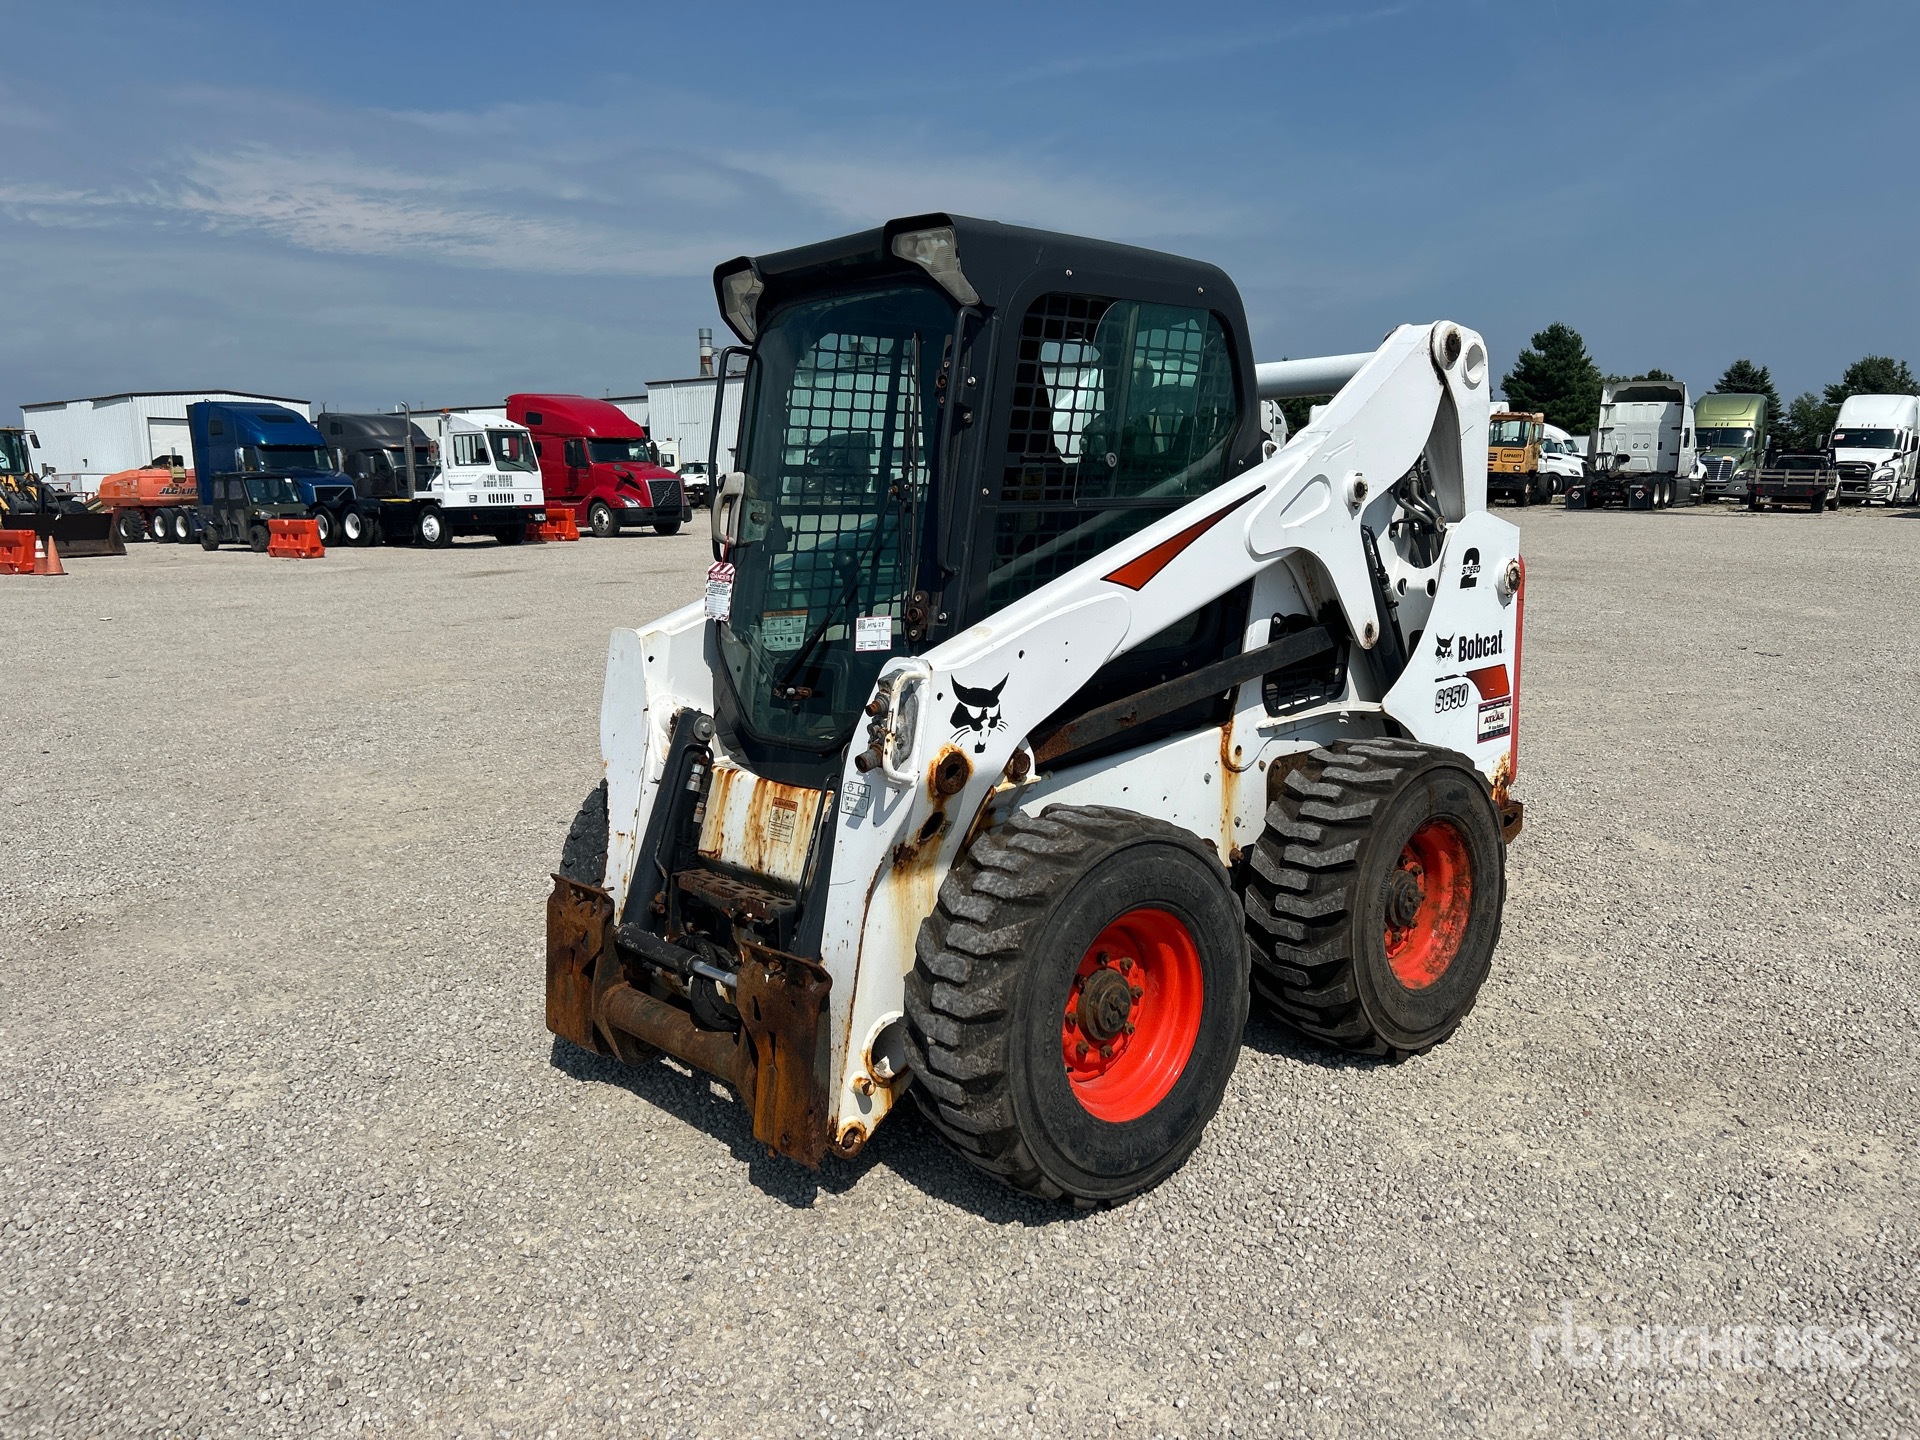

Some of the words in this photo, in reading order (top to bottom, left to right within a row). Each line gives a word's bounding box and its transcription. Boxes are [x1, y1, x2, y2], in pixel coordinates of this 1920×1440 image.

[159, 487, 179, 495] JLG
[1459, 547, 1480, 589] 2
[1458, 629, 1503, 662] Bobcat
[1435, 683, 1469, 713] S650
[1484, 712, 1504, 724] ATLAS
